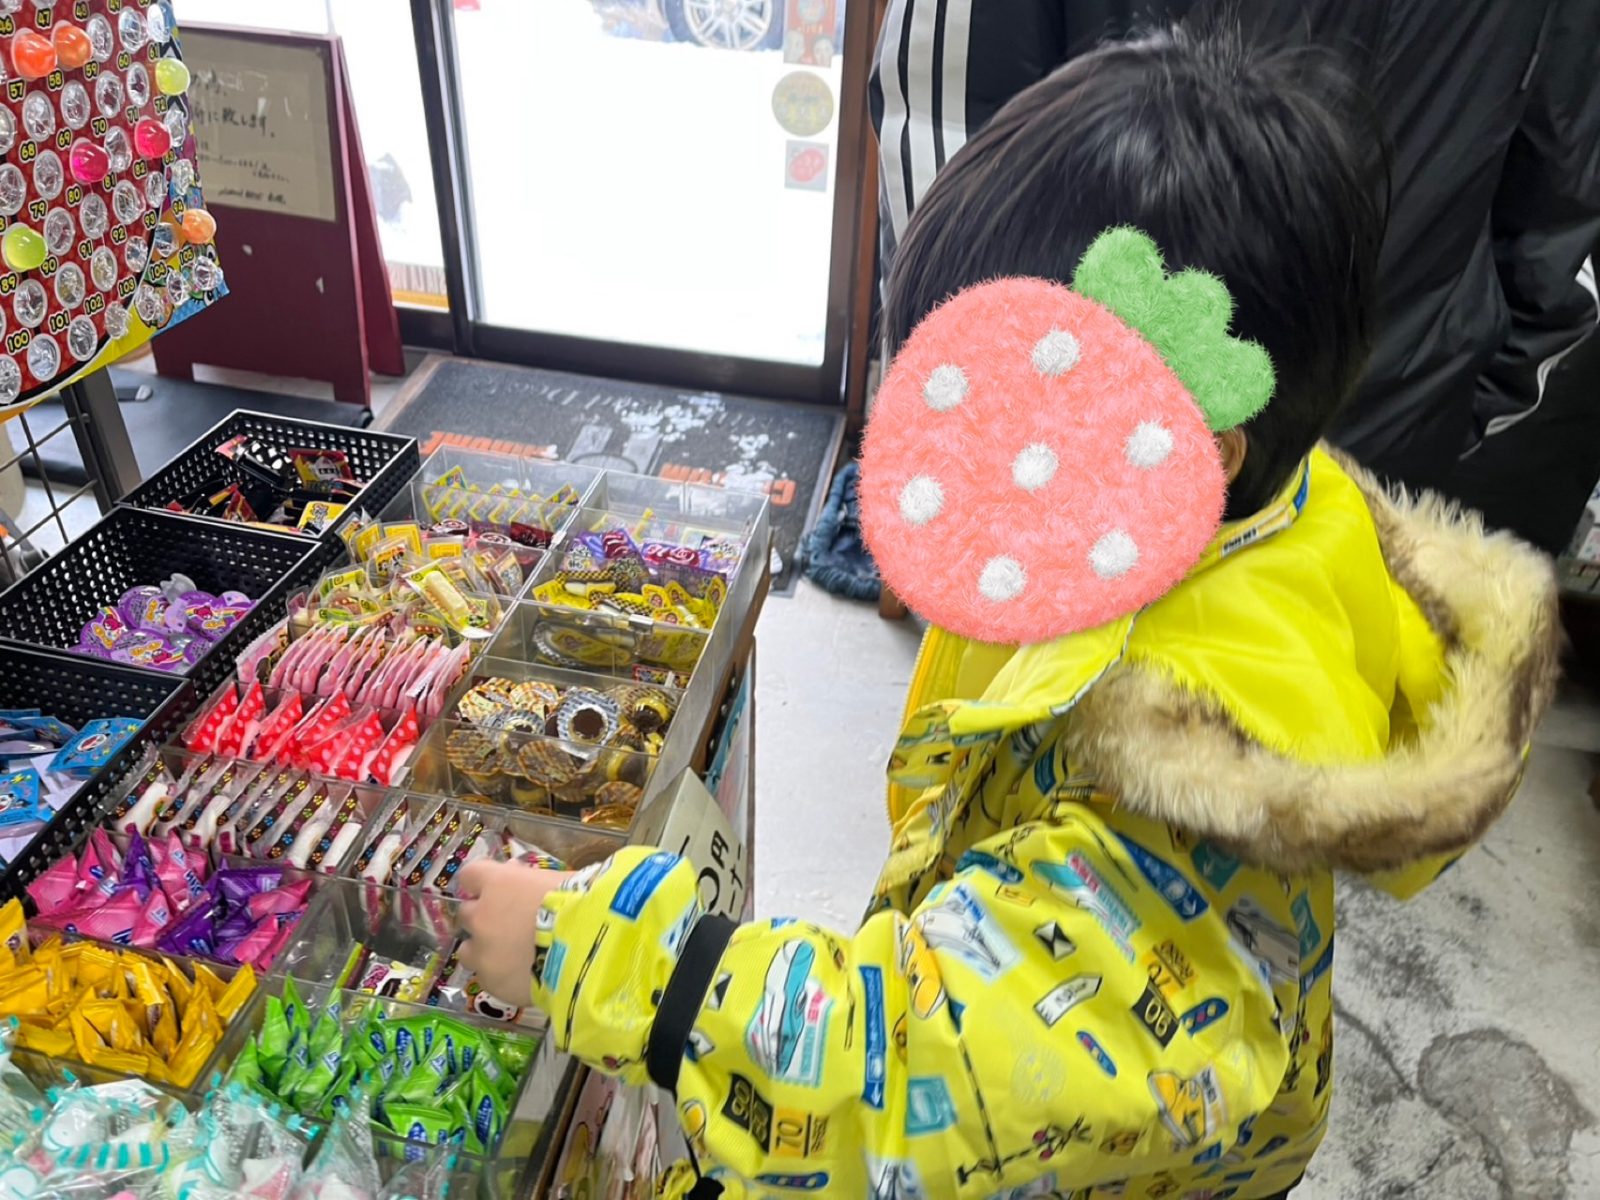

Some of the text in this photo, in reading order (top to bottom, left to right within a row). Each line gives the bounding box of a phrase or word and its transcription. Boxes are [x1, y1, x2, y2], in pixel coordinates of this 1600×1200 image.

[37, 8, 51, 27] 47
[118, 52, 130, 69] 60
[86, 63, 98, 78] 59
[49, 73, 62, 89] 58
[10, 82, 24, 98] 57
[127, 108, 139, 123] 71
[93, 120, 107, 135] 70
[58, 131, 71, 148] 69
[20, 143, 36, 161] 68
[134, 160, 146, 177] 82
[104, 174, 117, 190] 81
[68, 187, 81, 203] 80
[30, 201, 46, 219] 79
[112, 227, 125, 241] 92
[79, 241, 92, 258] 91
[41, 256, 57, 275] 90
[0, 273, 16, 293] 89
[119, 279, 135, 297] 103
[85, 296, 104, 314] 102
[50, 311, 70, 331] 101
[8, 331, 30, 351] 100
